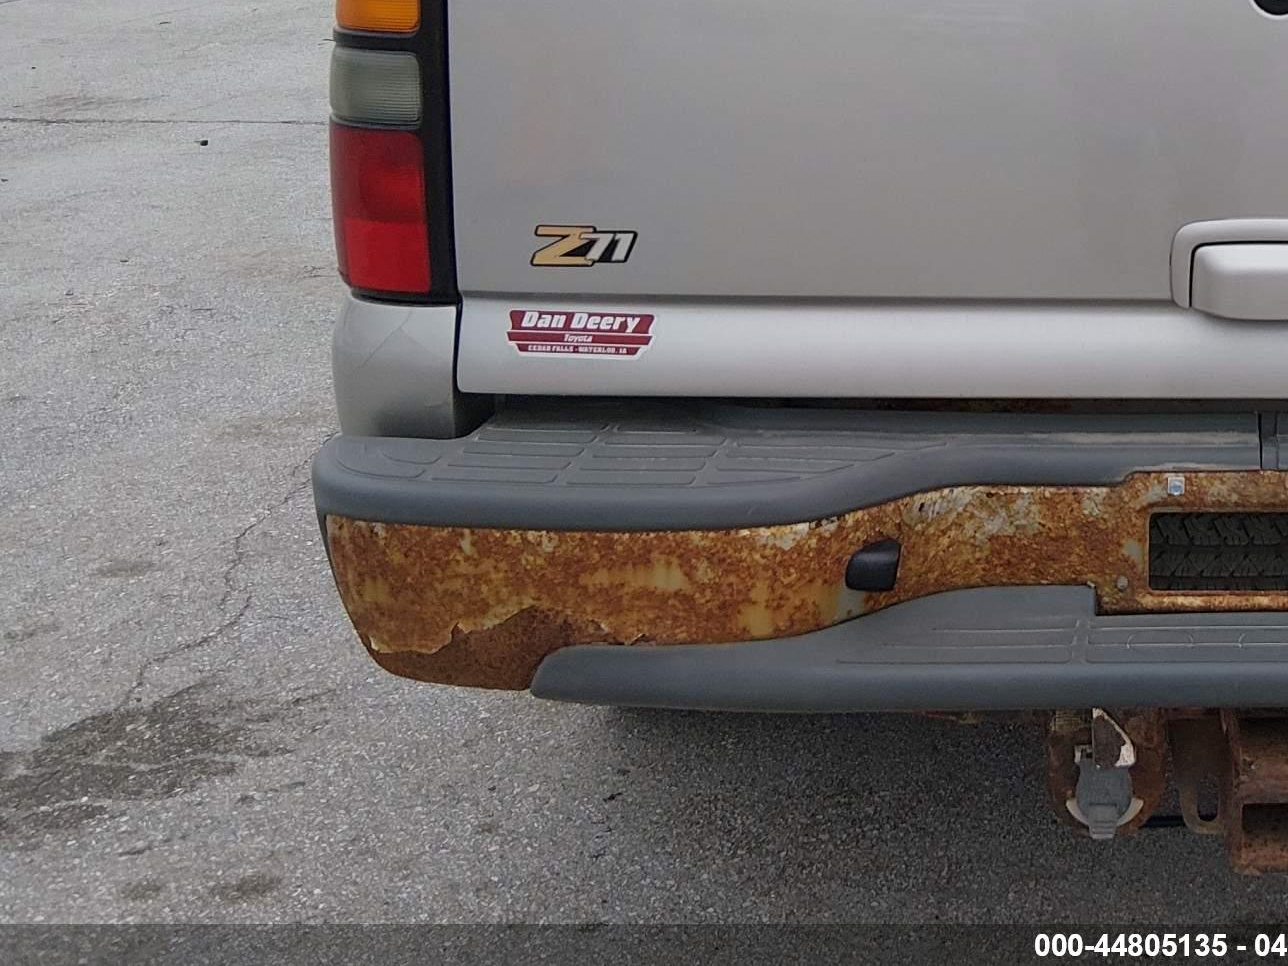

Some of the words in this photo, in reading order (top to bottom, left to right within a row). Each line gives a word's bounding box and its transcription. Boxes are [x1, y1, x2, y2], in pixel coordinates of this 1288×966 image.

[530, 224, 639, 267] Z71
[521, 311, 566, 329] Dan
[570, 312, 641, 332] Deery
[563, 333, 593, 343] Toyota
